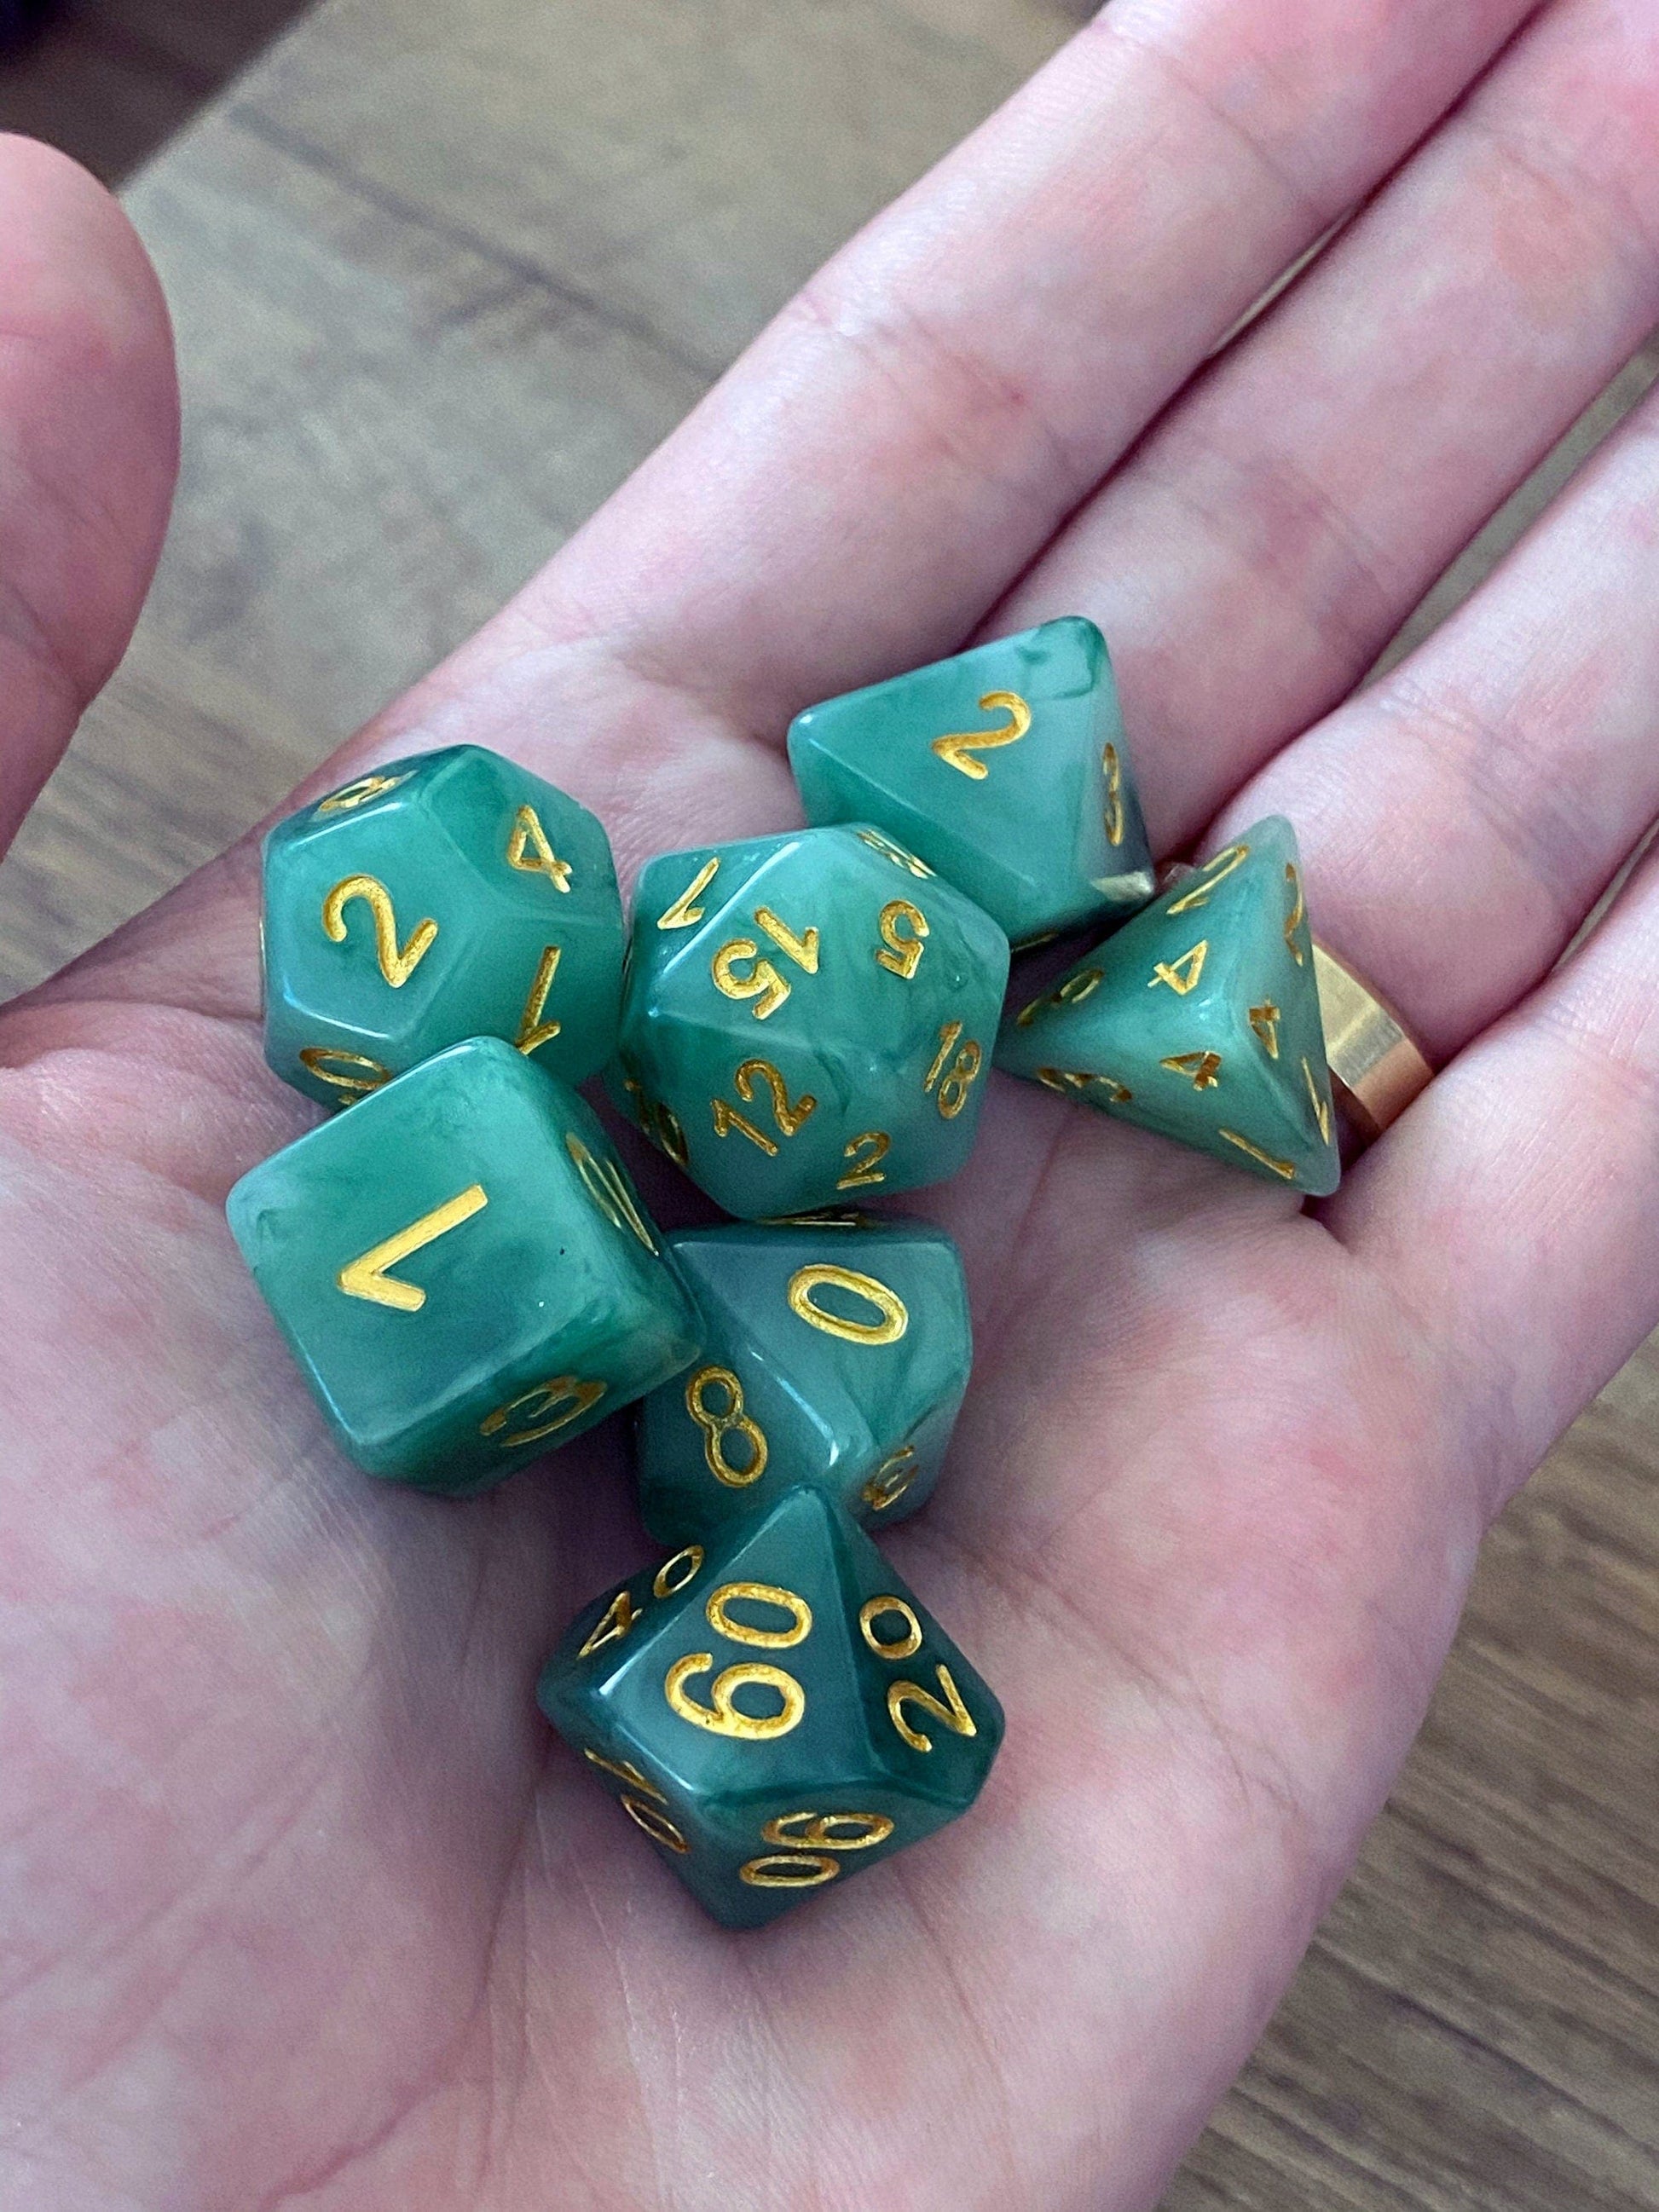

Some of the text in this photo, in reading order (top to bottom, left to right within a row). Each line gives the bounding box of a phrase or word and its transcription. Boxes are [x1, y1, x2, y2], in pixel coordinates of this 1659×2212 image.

[931, 690, 1032, 780] 2
[508, 805, 573, 893] 4
[321, 874, 439, 989] 2
[711, 906, 818, 1020] 15
[876, 899, 930, 980] 5
[1147, 940, 1208, 996] 4
[924, 1019, 982, 1119] 18
[1159, 1050, 1222, 1092] 4
[1249, 997, 1280, 1060] 4
[711, 1058, 818, 1157] 12
[836, 1131, 892, 1190] 2
[337, 1183, 489, 1312] 1
[787, 1263, 910, 1346] 0
[480, 1375, 609, 1448] 3
[685, 1366, 769, 1488] 8
[577, 1545, 704, 1660] 40
[664, 1582, 812, 1740] 60
[859, 1596, 977, 1753] 20
